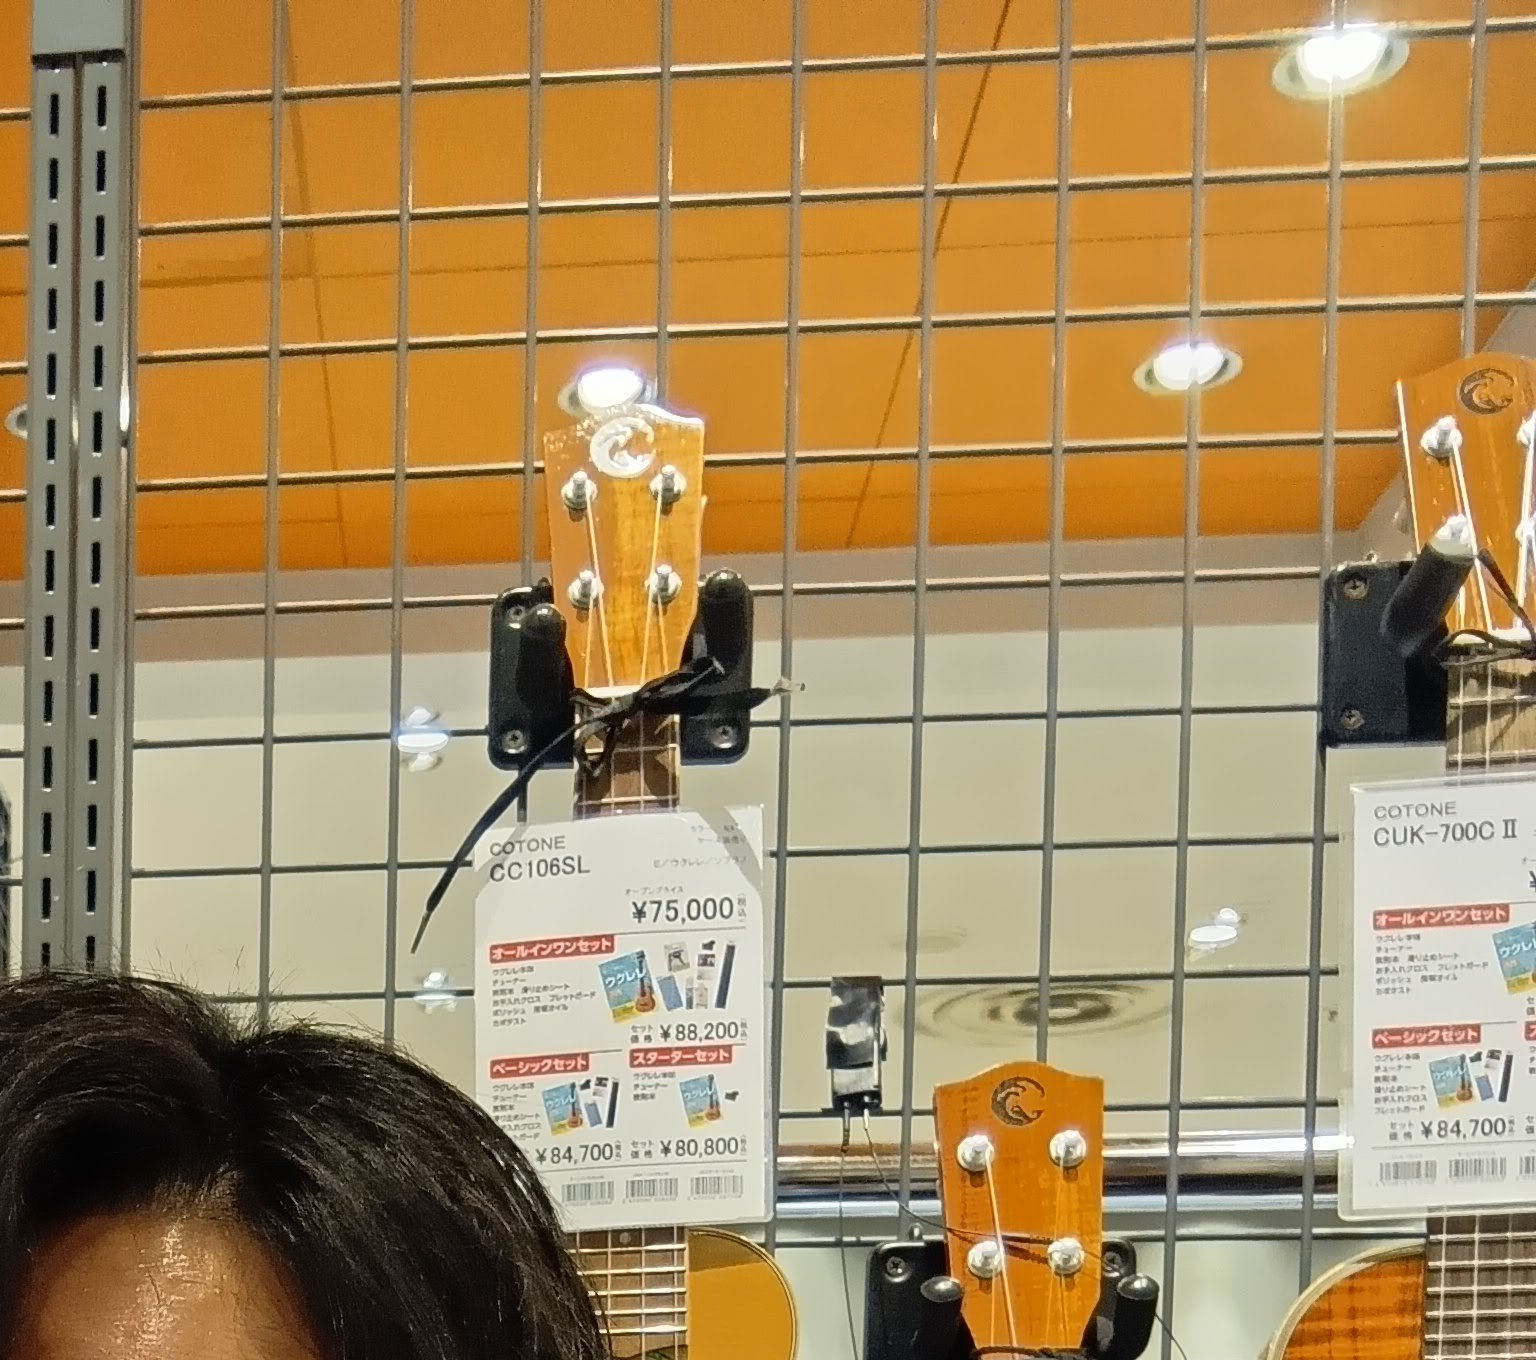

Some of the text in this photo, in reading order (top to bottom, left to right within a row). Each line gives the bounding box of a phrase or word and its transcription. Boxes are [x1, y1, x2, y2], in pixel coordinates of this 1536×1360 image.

[1374, 801, 1457, 819] COTONE
[490, 836, 565, 856] COTONE
[490, 856, 590, 882] CC106SL
[632, 898, 734, 924] ¥75,000
[1375, 907, 1507, 926] オールインワンセット
[491, 938, 612, 960] オールインワンセット
[605, 968, 646, 988] ウクレレ
[660, 1021, 739, 1042] ¥88,200
[1374, 1028, 1478, 1044] ベーシックセット
[492, 1057, 586, 1074] ベーシックセット
[634, 1049, 729, 1064] スターターセット
[1421, 1117, 1506, 1139] ¥84,700
[536, 1142, 613, 1165] ¥84,700
[660, 1137, 739, 1159] ¥80,800
